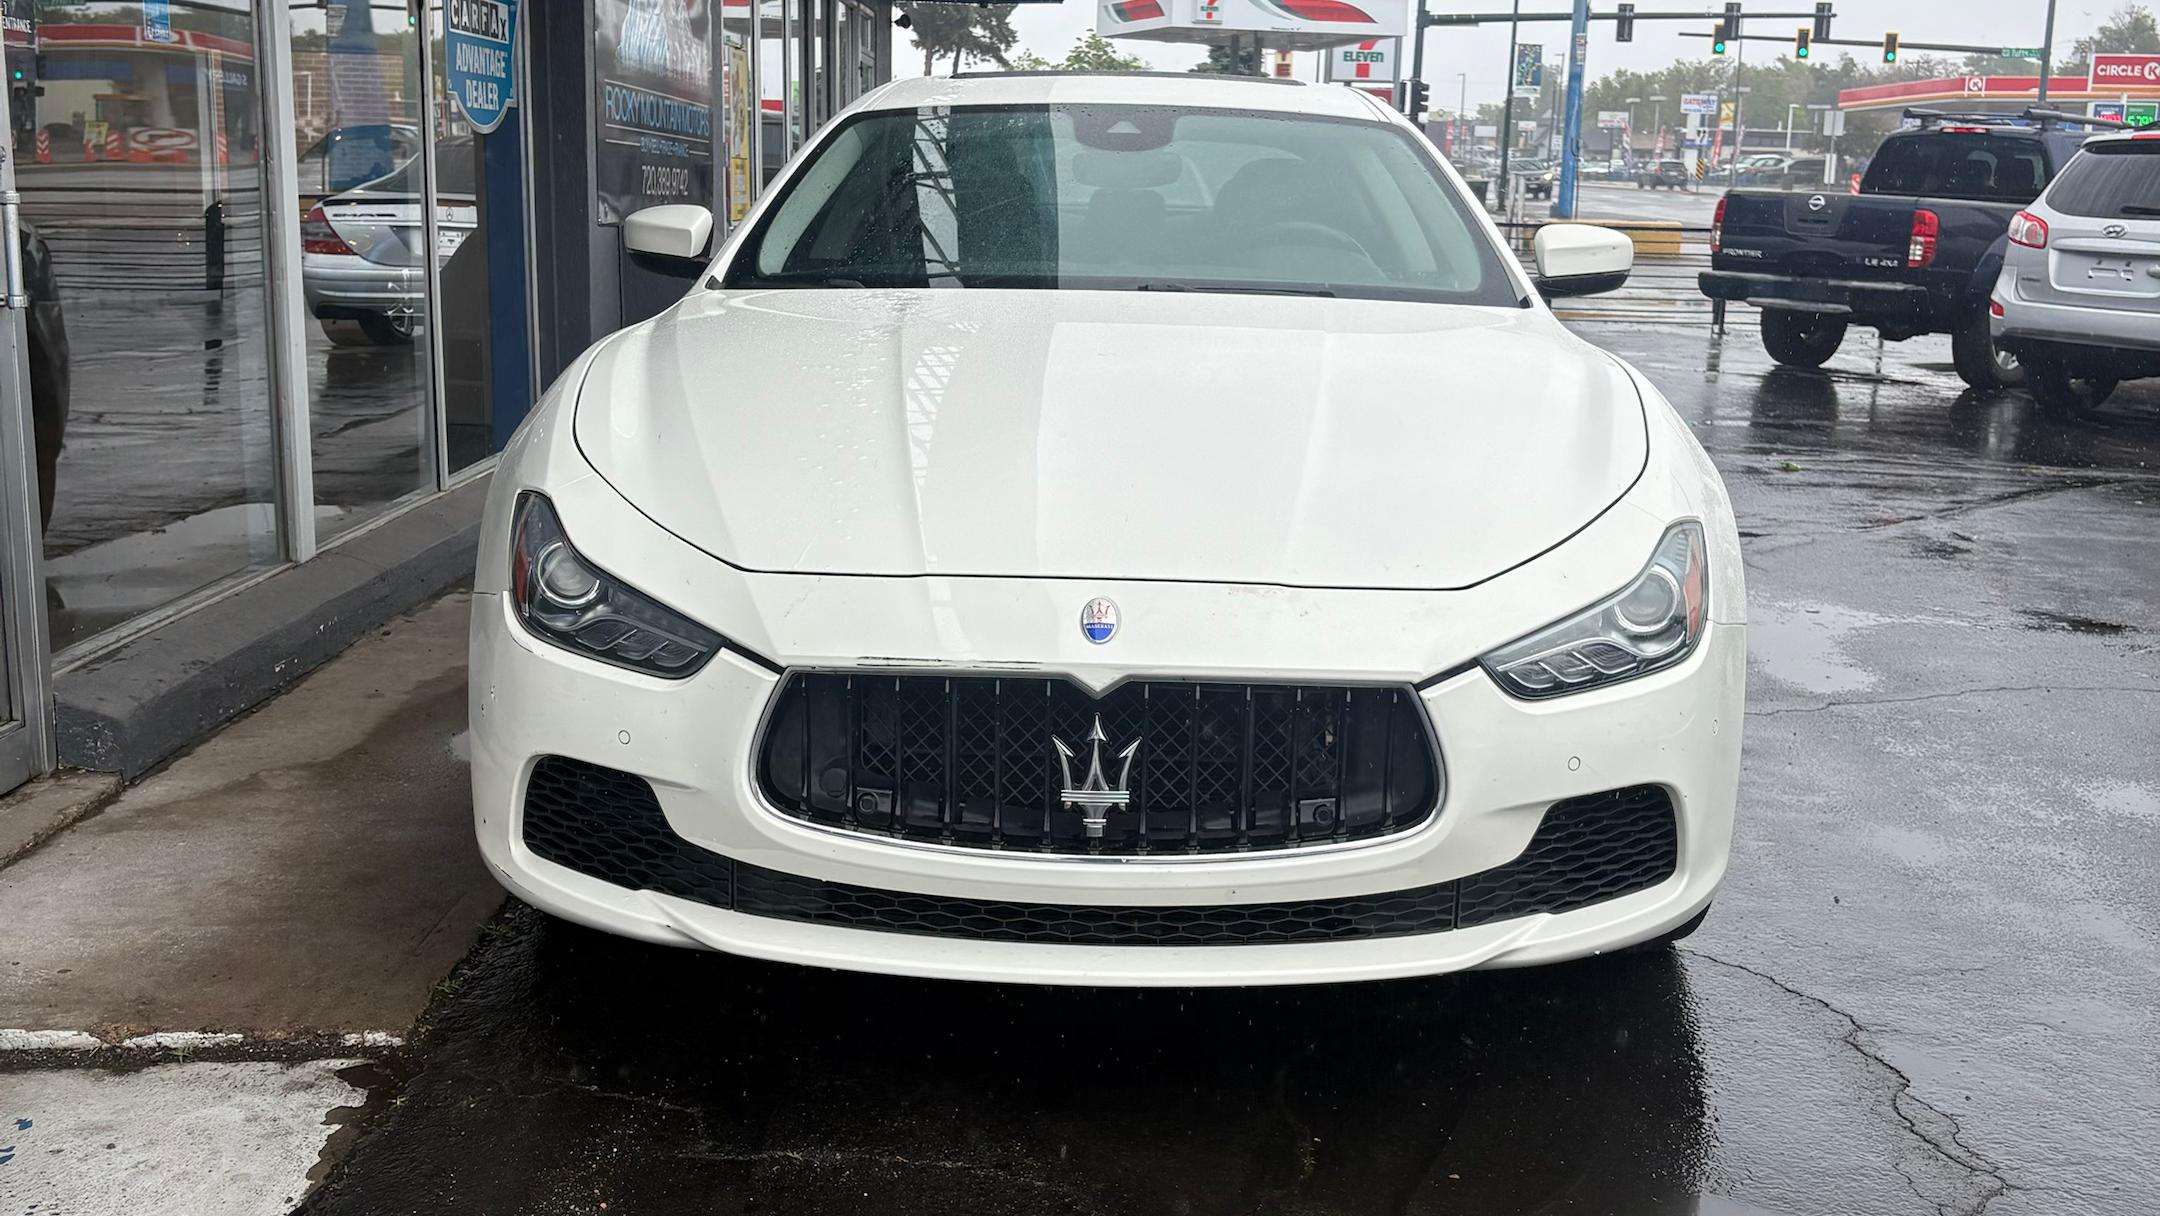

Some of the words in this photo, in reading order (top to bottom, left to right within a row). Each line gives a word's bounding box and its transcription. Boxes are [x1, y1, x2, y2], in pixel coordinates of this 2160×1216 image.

[2, 16, 32, 34] ENTRANCE
[450, 0, 508, 42] CARFAX
[455, 42, 507, 79] ADVANTAGE
[2096, 64, 2142, 77] CIRCLE
[465, 79, 500, 111] DEALER
[605, 85, 640, 123] ROCKY
[640, 93, 682, 132] MOUNTAIN
[682, 104, 710, 137] MOTORS
[1722, 248, 1763, 259] FRONTIER
